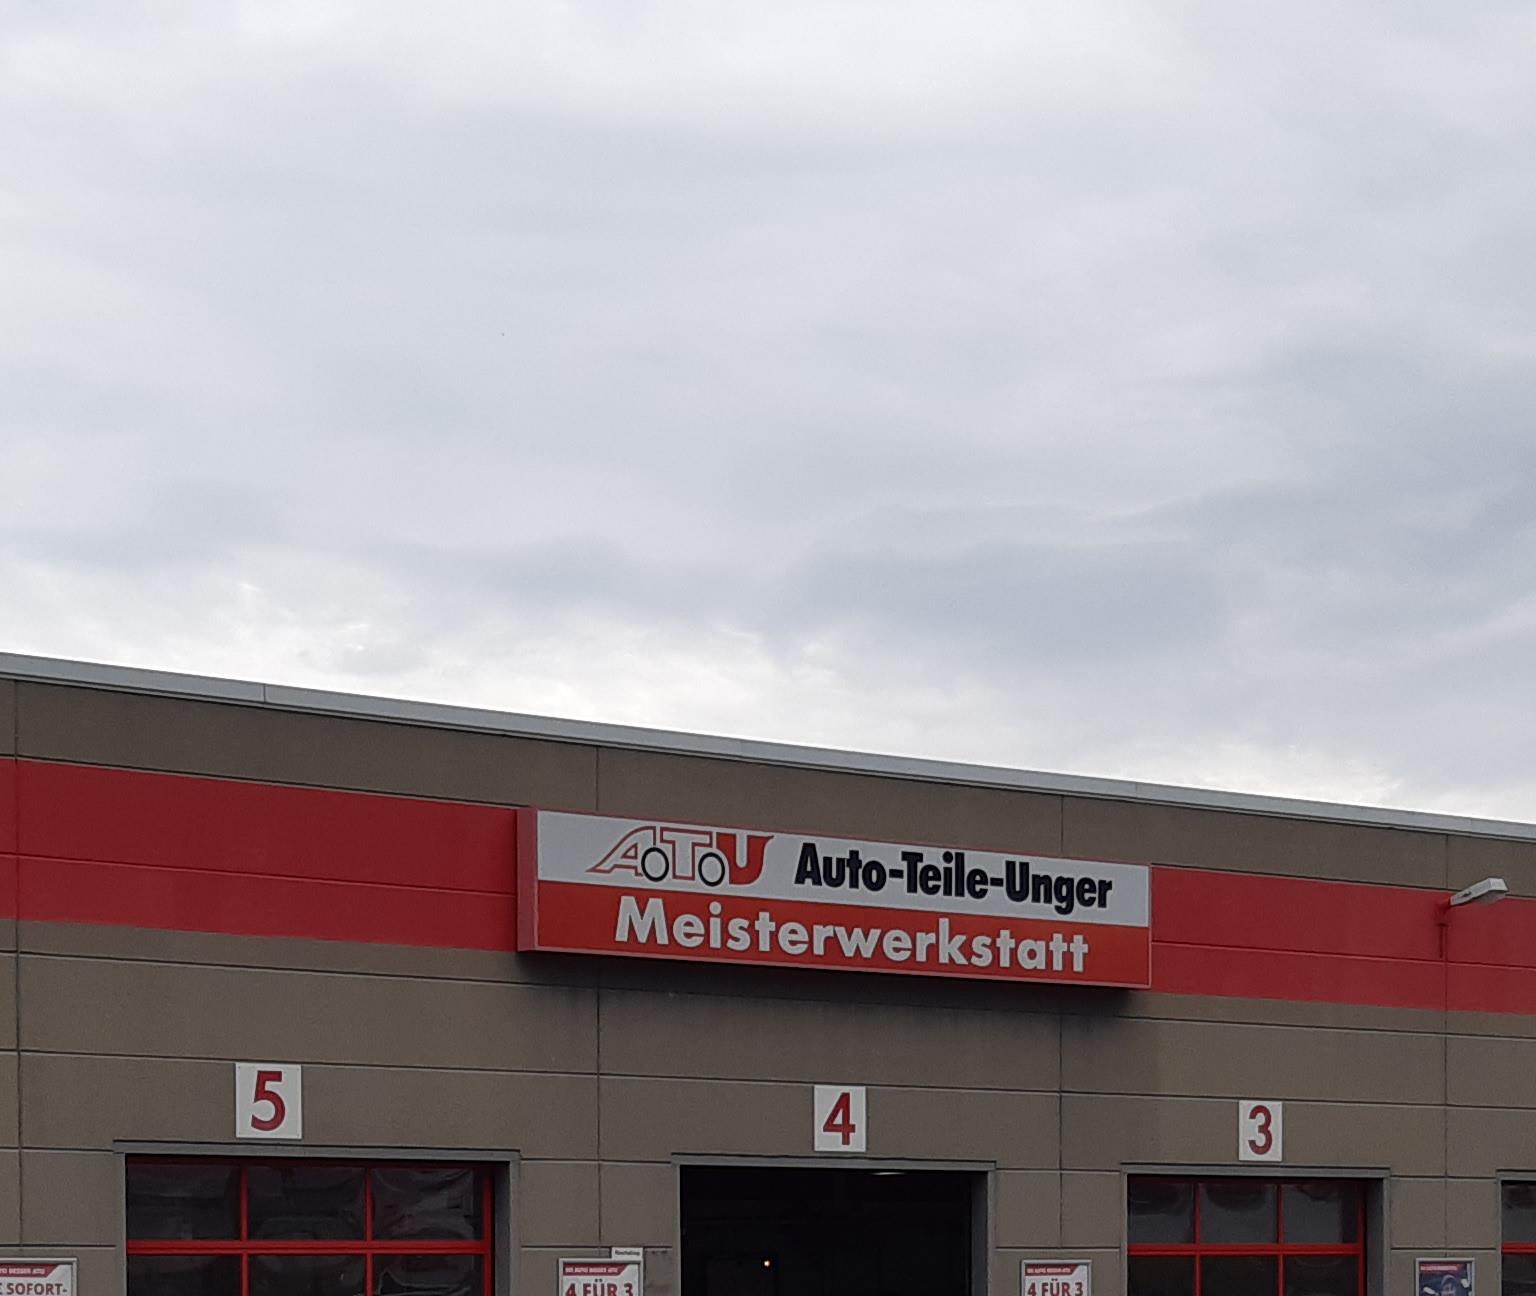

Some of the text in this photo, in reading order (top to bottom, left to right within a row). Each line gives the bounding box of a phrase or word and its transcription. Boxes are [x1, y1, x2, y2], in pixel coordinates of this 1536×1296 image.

[794, 842, 1113, 915] Auto-Teile-Unger
[615, 895, 1089, 972] Meisterwerkstatt
[251, 1070, 287, 1131] 5
[822, 1092, 856, 1146] 4
[1249, 1105, 1275, 1156] 3
[6, 1282, 68, 1295] SOFORT-
